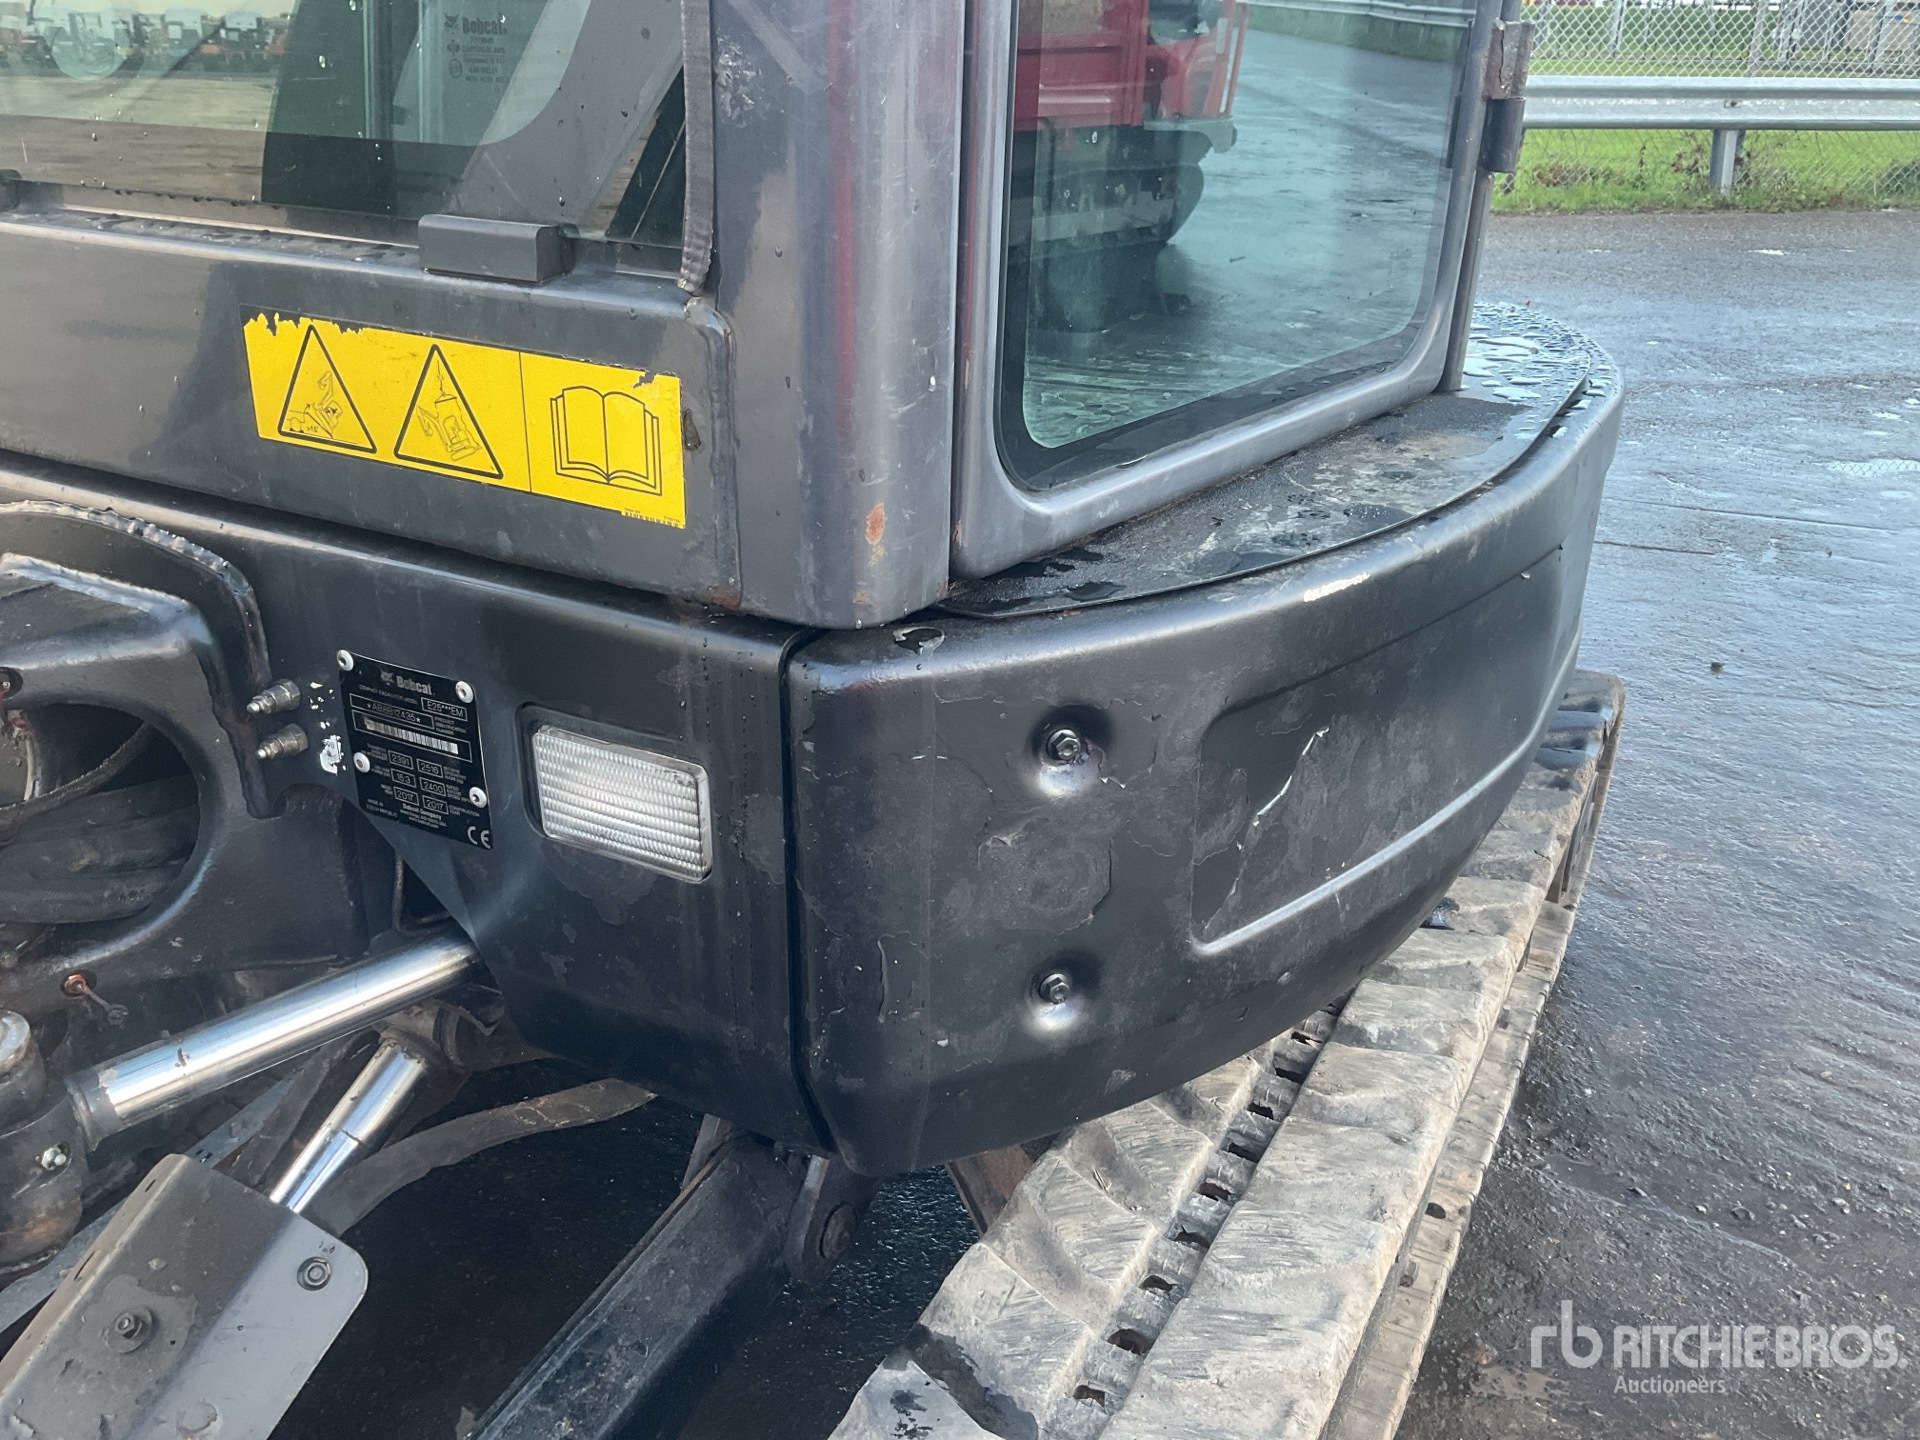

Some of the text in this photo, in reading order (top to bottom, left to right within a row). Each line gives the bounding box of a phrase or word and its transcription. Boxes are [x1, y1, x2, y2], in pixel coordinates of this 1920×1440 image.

[396, 675, 433, 695] Bobcat
[423, 781, 443, 794] 2400
[397, 790, 413, 801] 2017
[426, 799, 443, 811] 2017
[467, 825, 491, 849] CE
